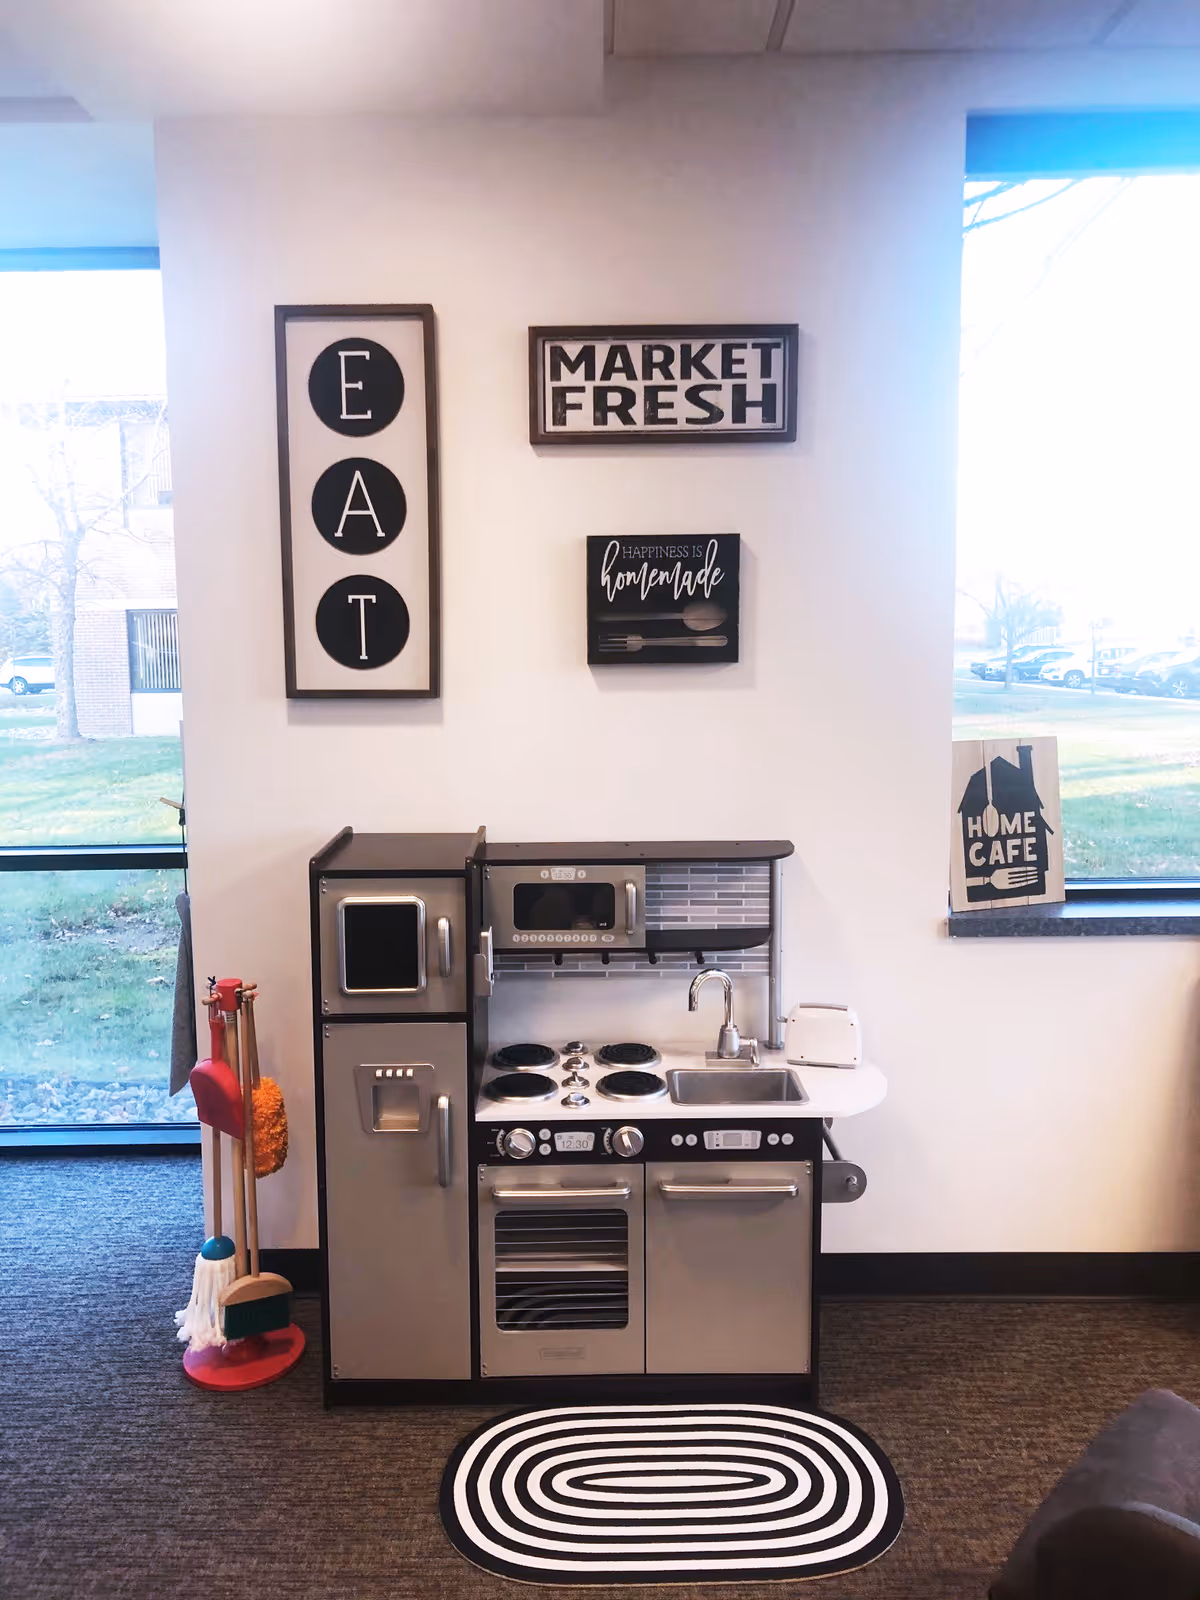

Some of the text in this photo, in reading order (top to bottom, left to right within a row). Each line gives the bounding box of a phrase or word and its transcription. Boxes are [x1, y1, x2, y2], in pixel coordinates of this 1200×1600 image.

[550, 342, 781, 382] MARKET
[552, 383, 777, 426] FRESH
[622, 545, 703, 559] HAPPINESS IS
[601, 539, 725, 602] homemade
[967, 811, 1036, 838] HOME
[969, 837, 1038, 867] CAFE
[561, 1140, 589, 1149] 12:30
